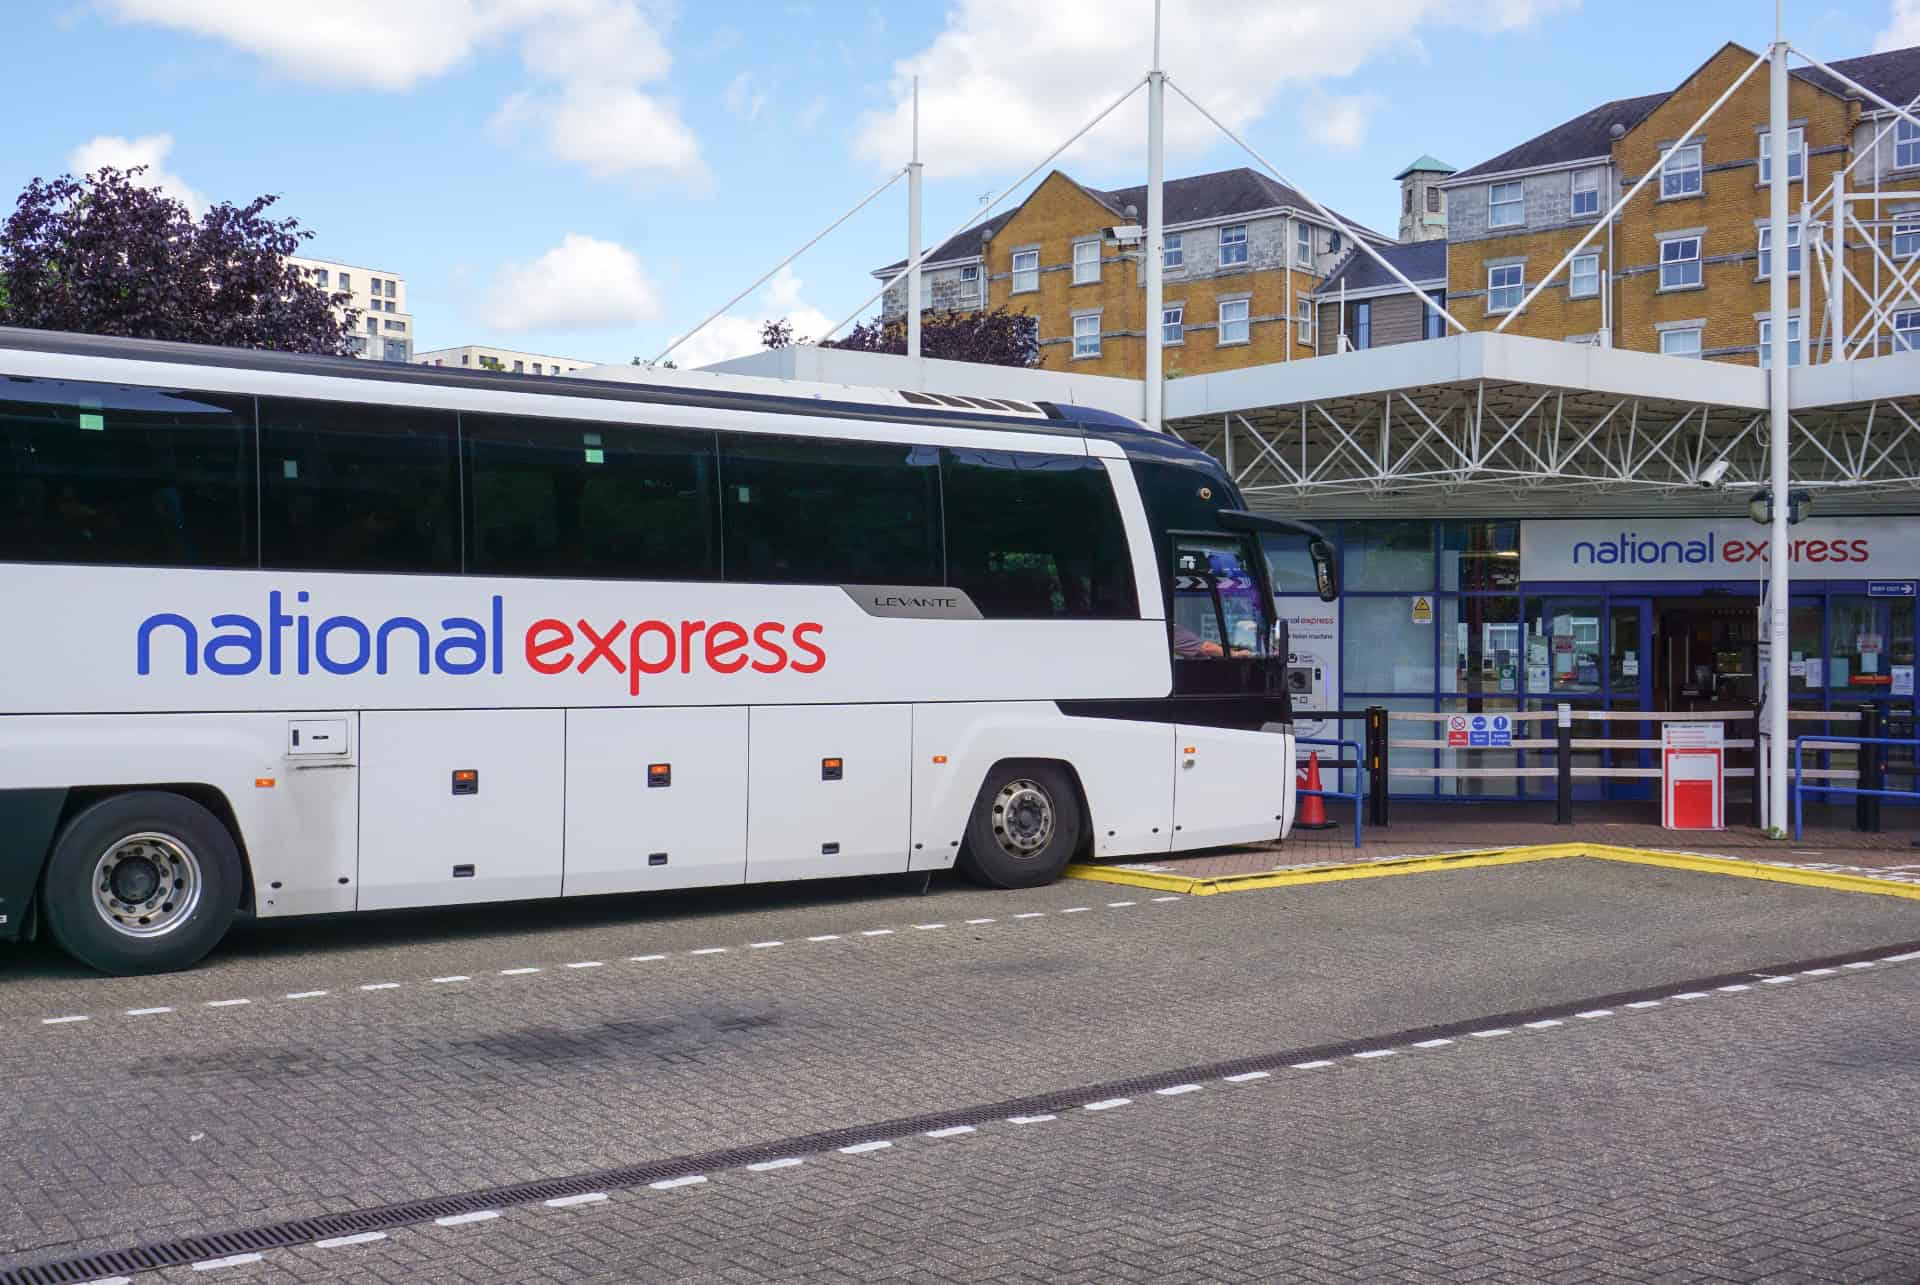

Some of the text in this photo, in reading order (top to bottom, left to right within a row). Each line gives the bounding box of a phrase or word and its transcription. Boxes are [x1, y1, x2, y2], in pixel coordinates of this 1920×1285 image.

[1573, 532, 1869, 564] national exress
[874, 597, 958, 608] LEVANTE
[137, 590, 826, 696] national express
